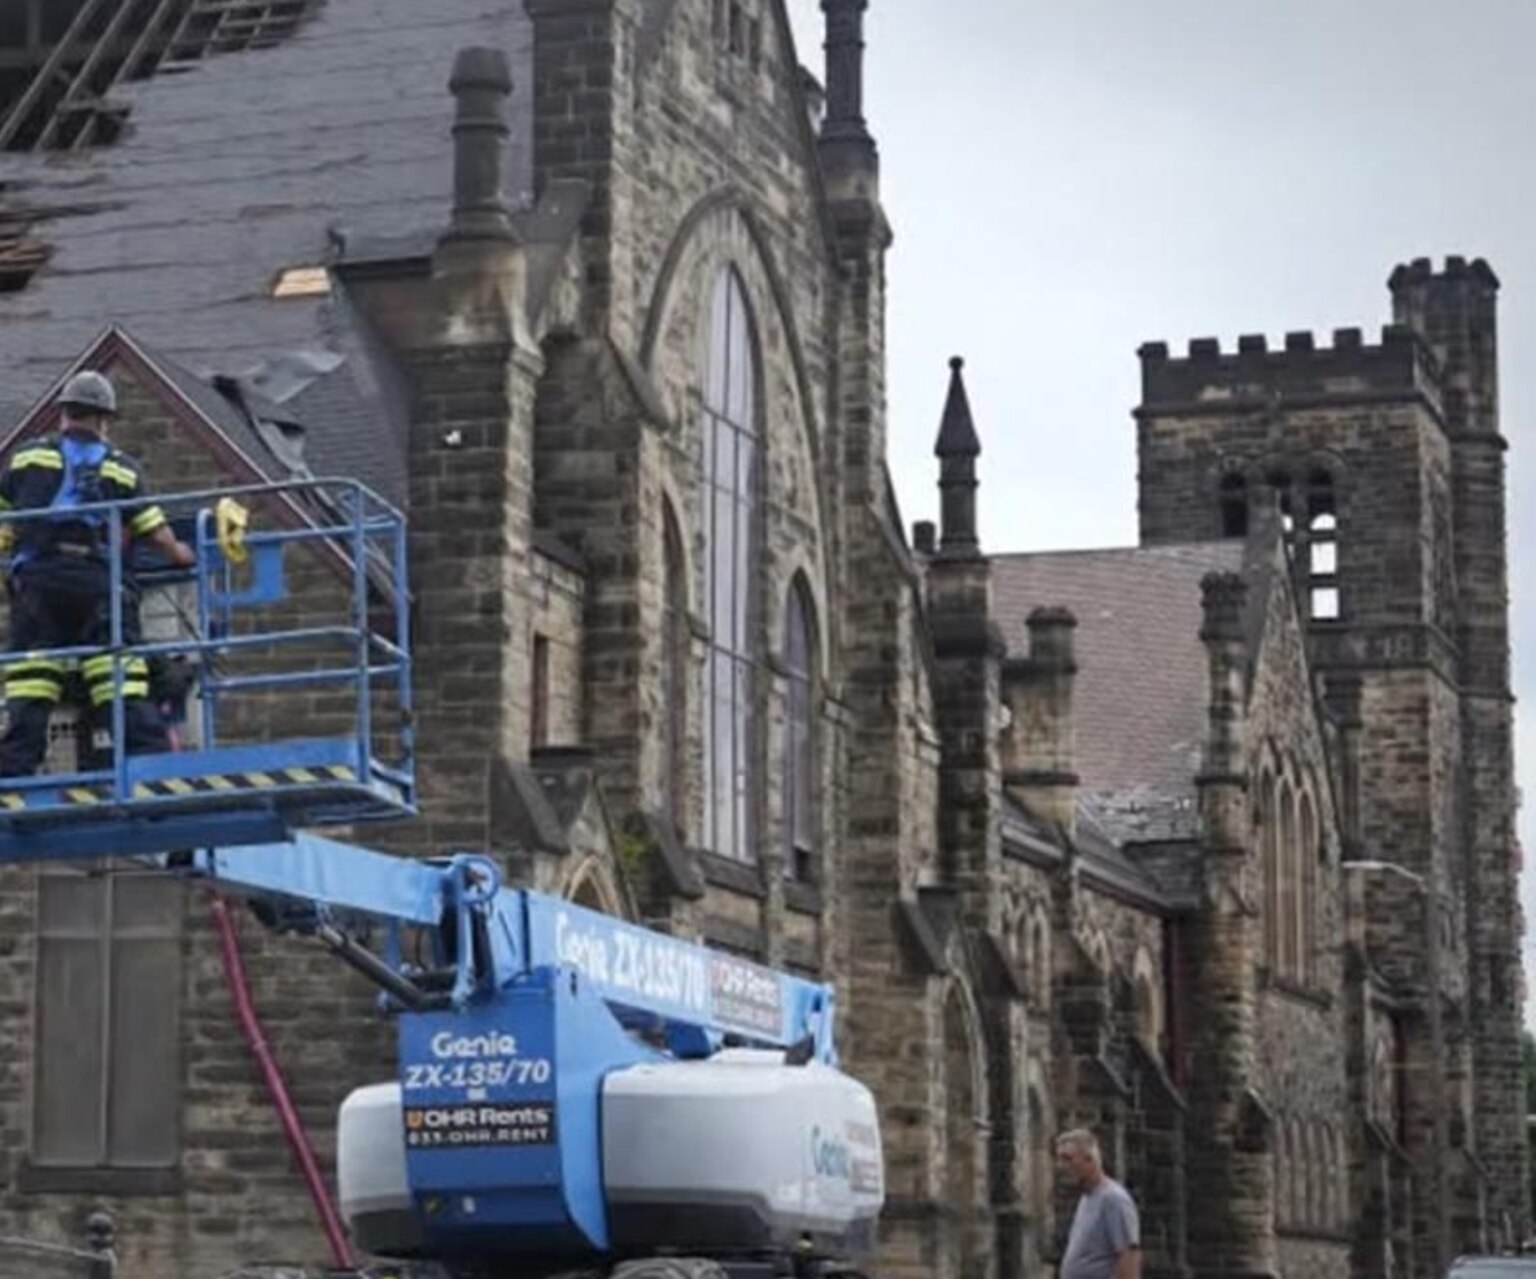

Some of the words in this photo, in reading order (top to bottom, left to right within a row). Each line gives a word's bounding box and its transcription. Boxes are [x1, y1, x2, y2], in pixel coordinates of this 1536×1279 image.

[556, 911, 609, 982] Genie
[614, 928, 705, 1010] ZX-135/70
[431, 1030, 517, 1058] Genie
[404, 1059, 551, 1089] ZX-135/70
[424, 1109, 477, 1127] OHR
[480, 1106, 549, 1125] Rents
